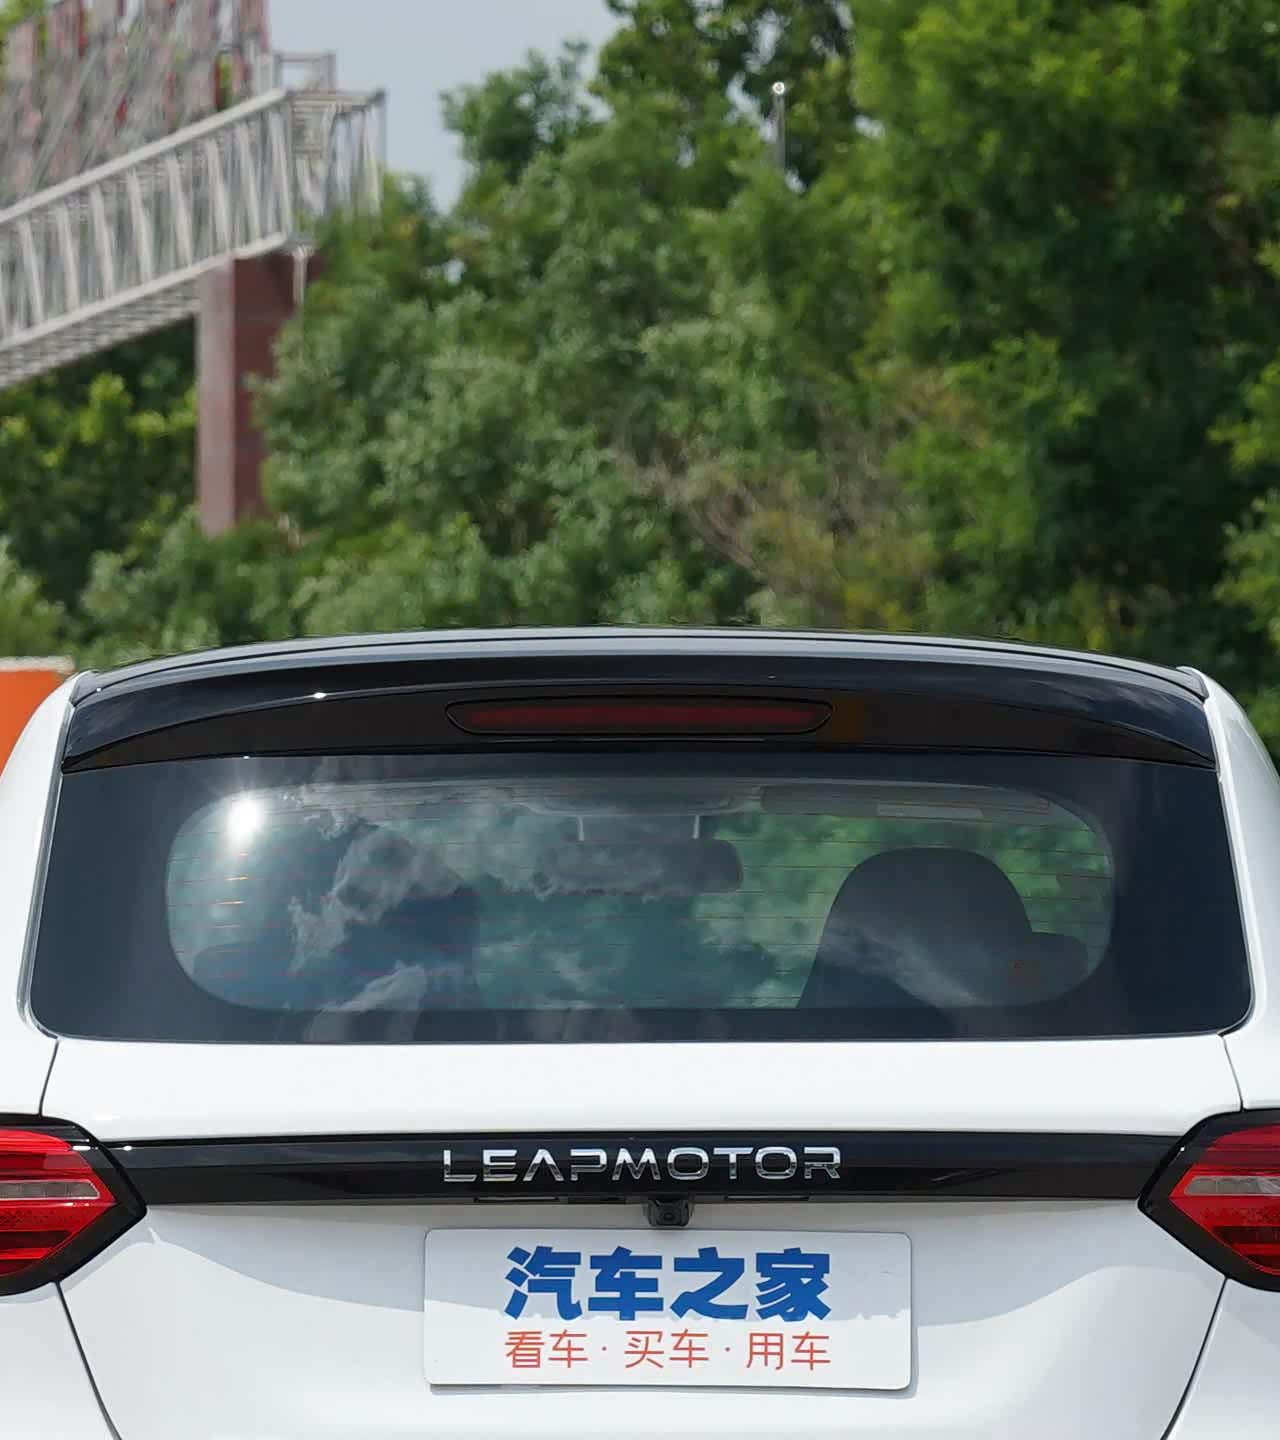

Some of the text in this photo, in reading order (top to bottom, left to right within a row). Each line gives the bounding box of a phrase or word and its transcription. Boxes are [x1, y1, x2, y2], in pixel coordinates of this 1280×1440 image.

[443, 1145, 842, 1182] LEAPMOTOR
[505, 1246, 832, 1322] 汽车之家
